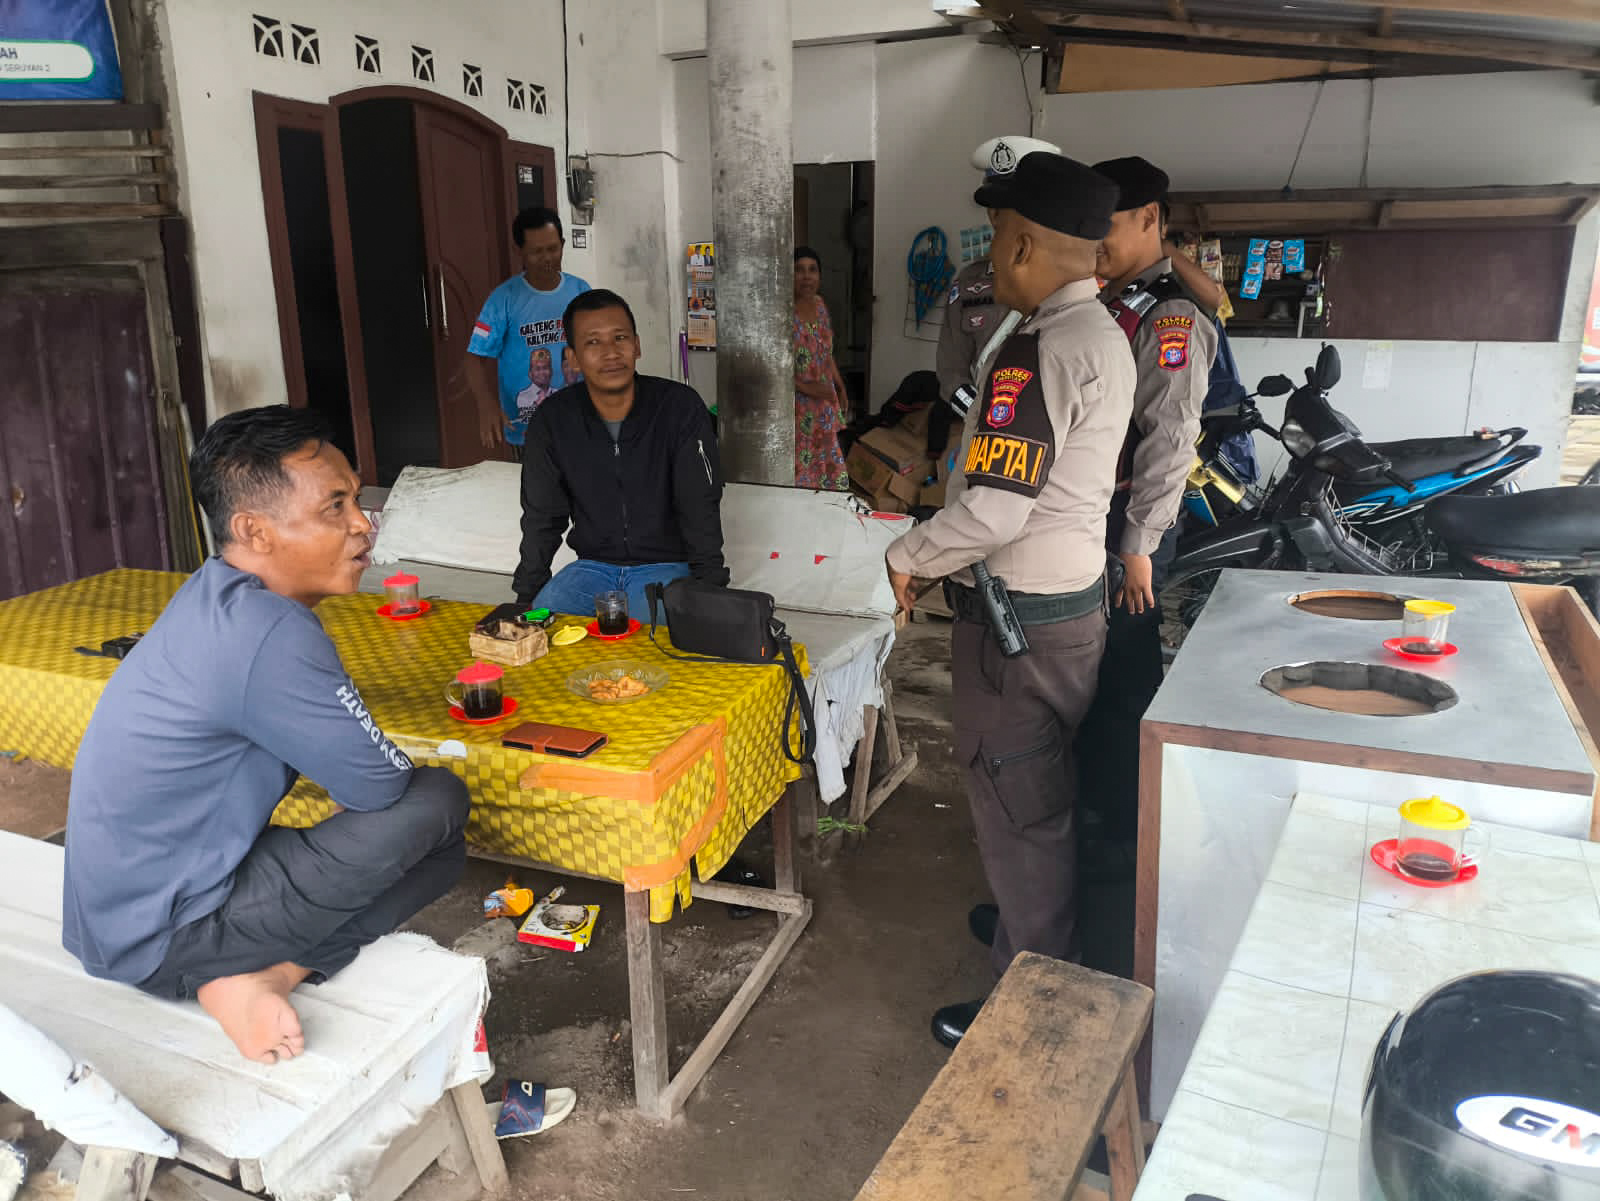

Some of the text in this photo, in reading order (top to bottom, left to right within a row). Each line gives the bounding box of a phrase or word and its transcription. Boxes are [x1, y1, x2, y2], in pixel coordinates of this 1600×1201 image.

[519, 319, 555, 337] KALTENG
[526, 331, 559, 347] KALTENG
[995, 369, 1029, 381] POLRES
